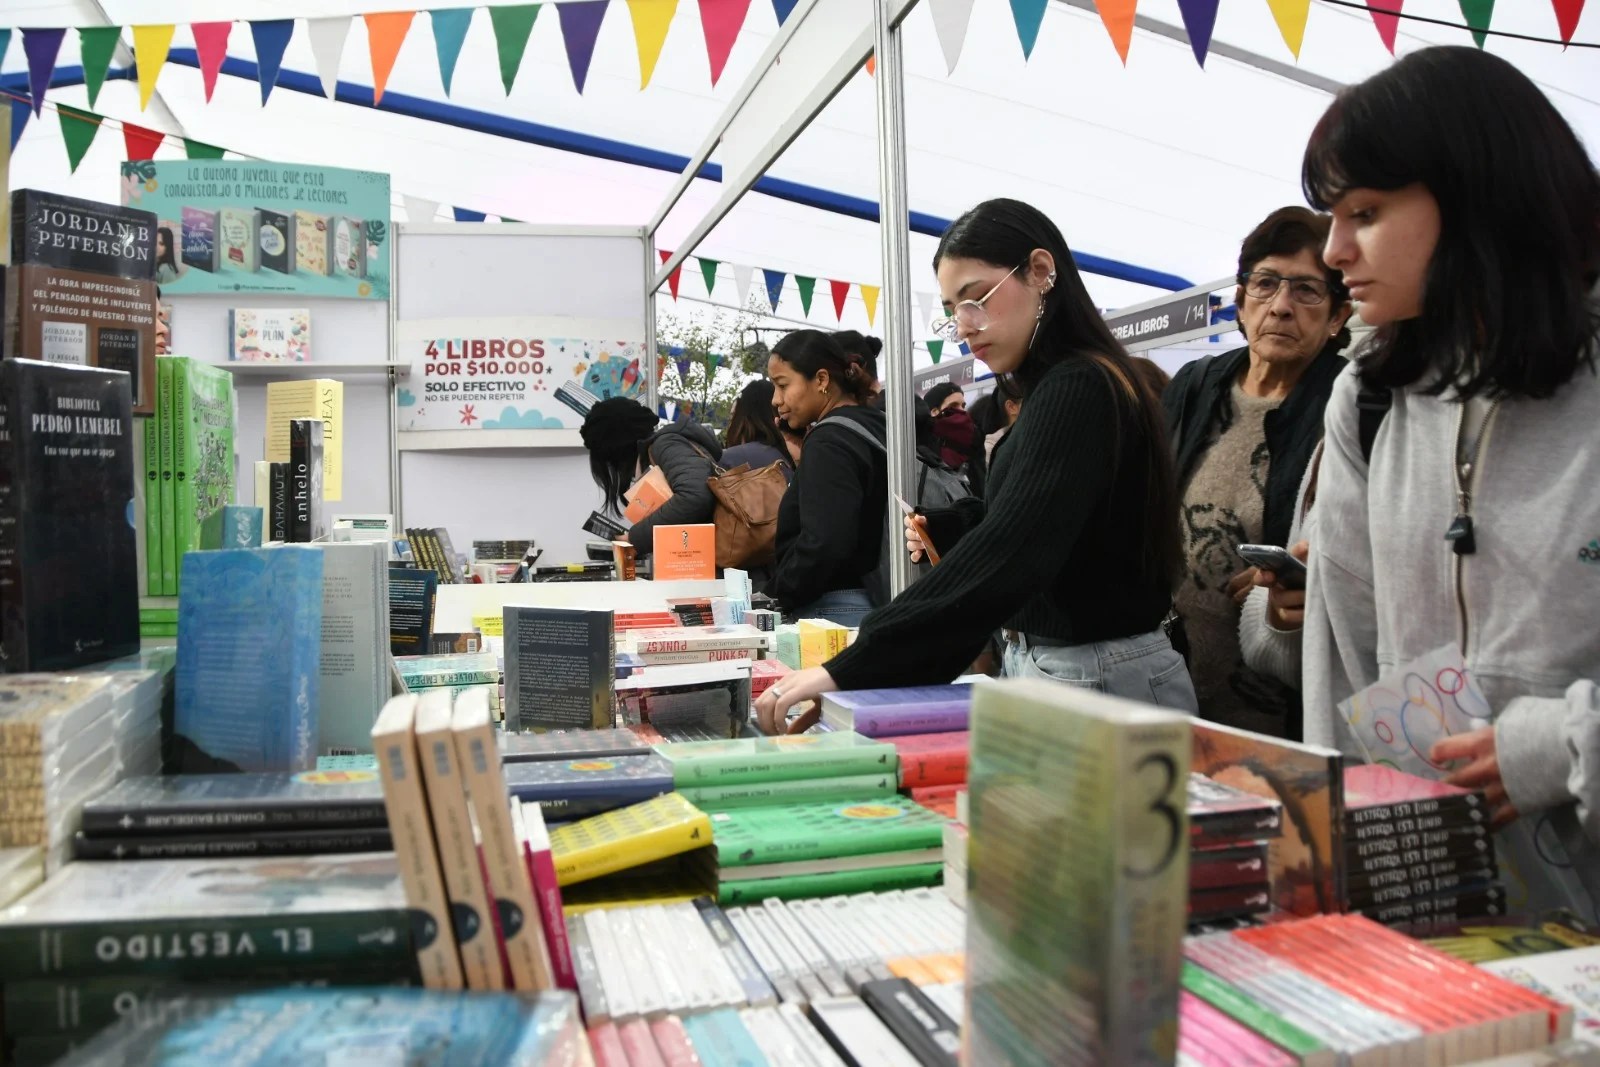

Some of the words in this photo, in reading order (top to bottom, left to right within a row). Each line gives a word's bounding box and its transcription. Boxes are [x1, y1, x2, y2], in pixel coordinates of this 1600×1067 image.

[38, 209, 131, 238] JORDAN
[137, 227, 149, 242] B
[38, 231, 149, 261] PETERSON
[48, 277, 57, 286] LA
[59, 279, 80, 288] OBRA
[82, 280, 141, 297] IMPRESCINDIBLE
[33, 289, 48, 299] DEL
[51, 290, 90, 303] PENSADOR
[92, 296, 108, 306] MÁS
[110, 299, 152, 311] INFLUYENTE
[32, 304, 38, 312] Y
[40, 304, 79, 316] POLÉMICO
[92, 310, 126, 321] NUESTRO
[127, 315, 153, 325] TIEMPO
[1135, 314, 1170, 336] LIBROS
[262, 329, 285, 341] PLAN
[425, 340, 439, 360] 4
[447, 339, 545, 360] LIBROS
[425, 361, 461, 376] POR
[467, 360, 544, 376] $10.000
[425, 381, 459, 392] SOLO
[463, 381, 526, 392] EFECTIVO
[921, 379, 931, 391] LOS
[57, 396, 101, 412] BIBLIOTECA
[425, 394, 437, 402] NO
[439, 394, 449, 402] SE
[451, 393, 487, 402] PUEDEN
[488, 393, 525, 401] REPETIR
[323, 388, 333, 440] IDEAS
[32, 413, 72, 434] PEDRO
[75, 416, 122, 436] LEMEBEL
[294, 463, 308, 522] anhelo
[275, 473, 284, 538] BAHAMUT
[646, 641, 658, 653] 57
[659, 640, 687, 652] PUNK
[709, 650, 735, 662] PUNK
[738, 650, 749, 659] 57
[448, 673, 479, 684] VOLVER
[751, 764, 770, 772] EMILY
[554, 799, 568, 807] LAS
[145, 814, 215, 826] BAUDELAIRE
[216, 811, 265, 824] CHARLES
[1123, 751, 1182, 880] 3
[138, 842, 207, 855] BAUDELAIRE
[207, 840, 259, 852] CHARLES
[95, 931, 257, 961] VESTIDO
[272, 928, 314, 952] EL
